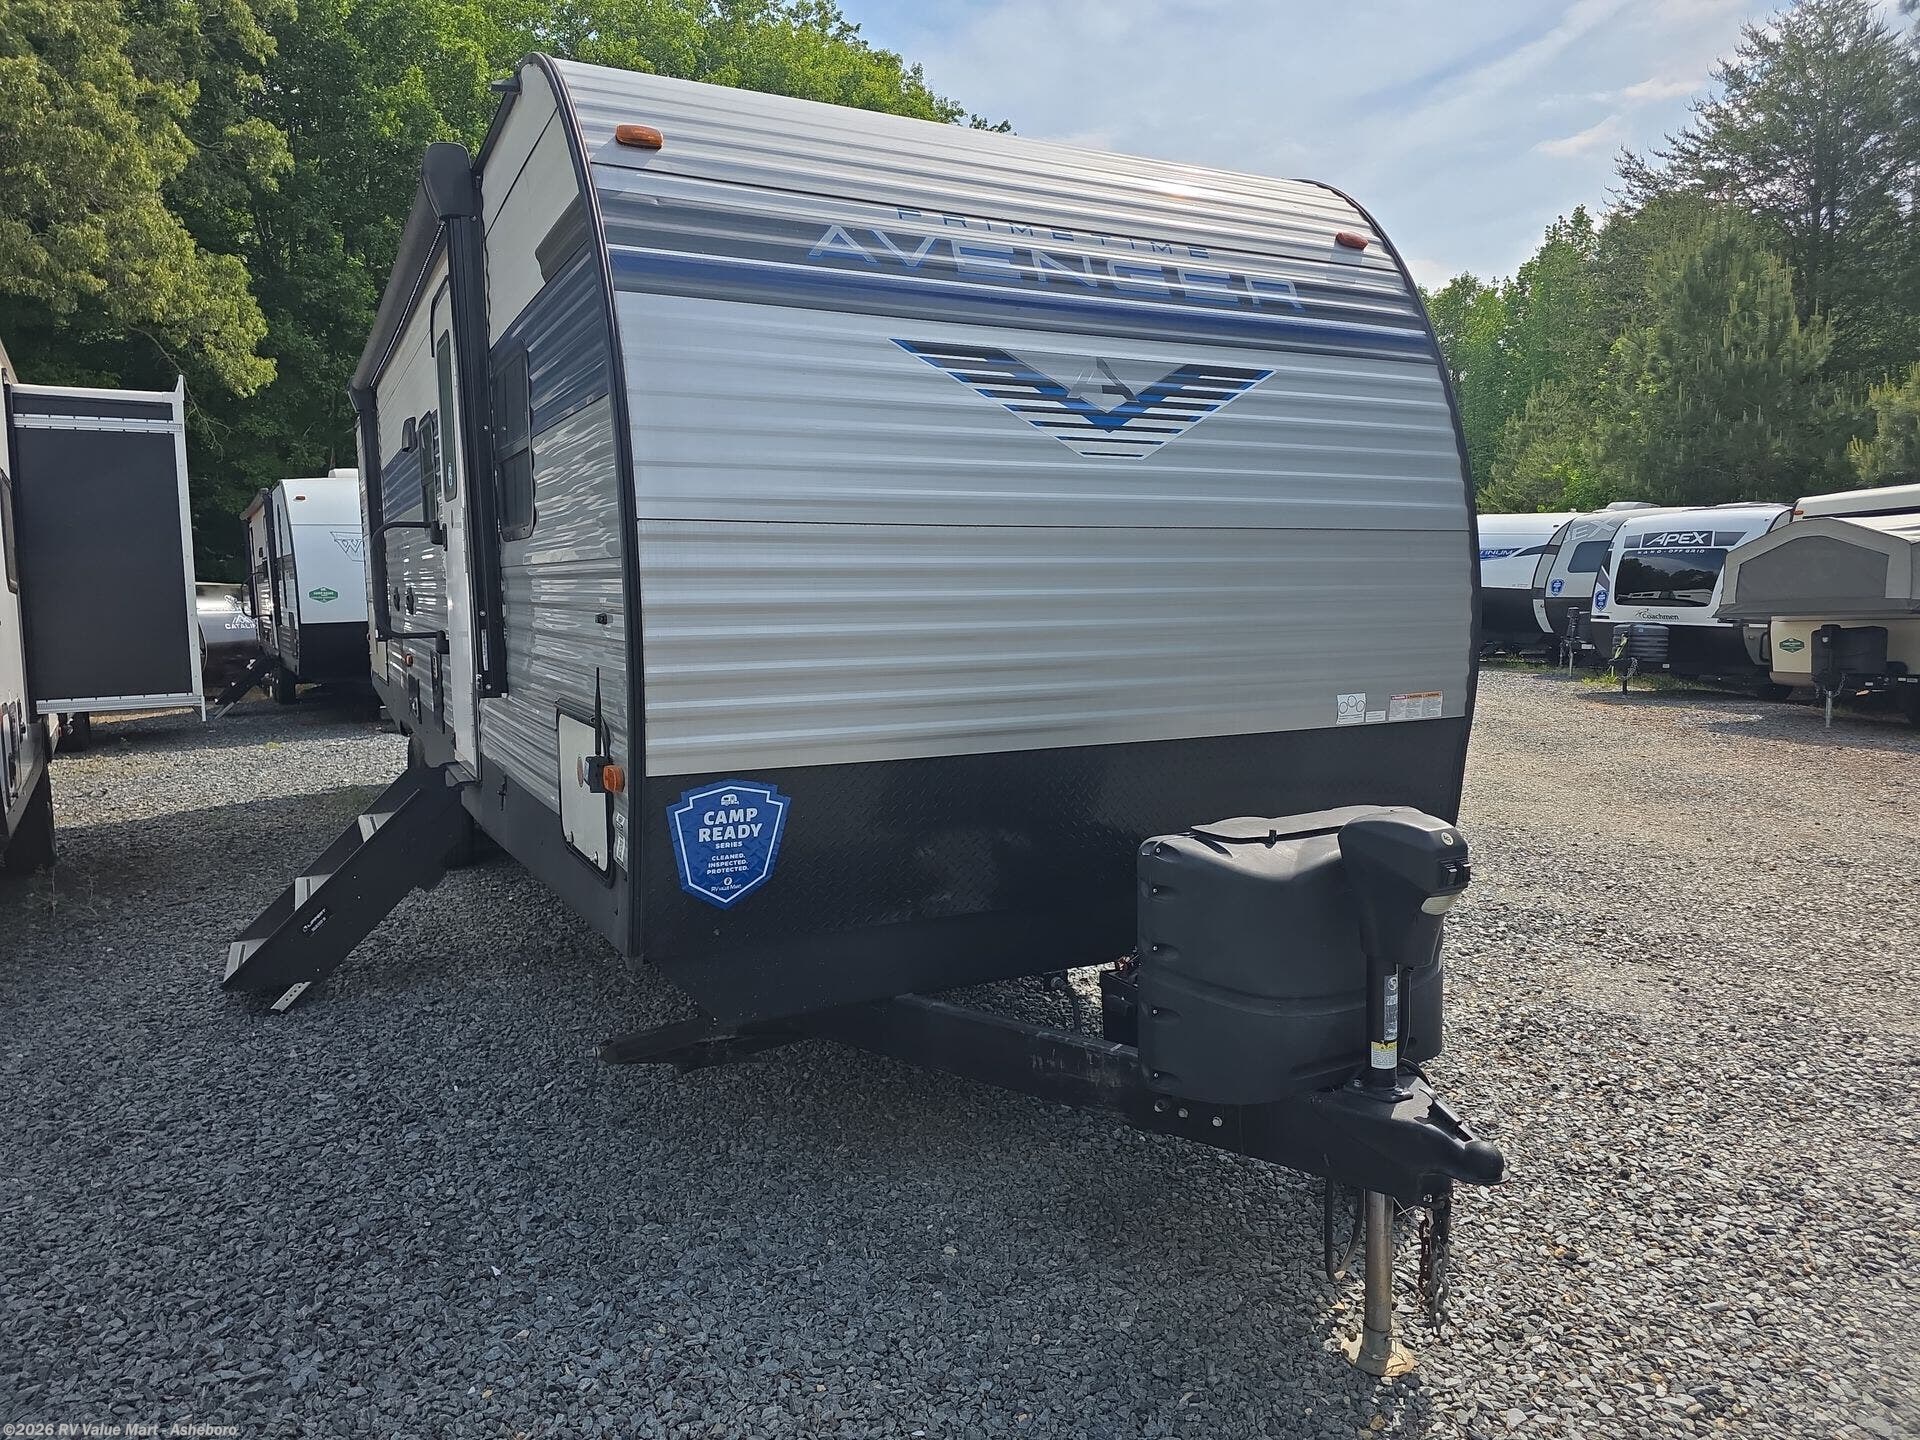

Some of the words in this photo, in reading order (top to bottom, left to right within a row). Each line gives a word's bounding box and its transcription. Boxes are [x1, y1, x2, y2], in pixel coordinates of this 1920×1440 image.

[808, 225, 1303, 308] AVENGER
[1645, 531, 1709, 546] APEX
[703, 808, 758, 826] CAMP
[698, 823, 762, 842] READY
[715, 841, 743, 849] SERIES
[711, 853, 746, 861] CLEANED.
[708, 860, 748, 868] INSPECTED.
[706, 866, 749, 875] PROTECTED.
